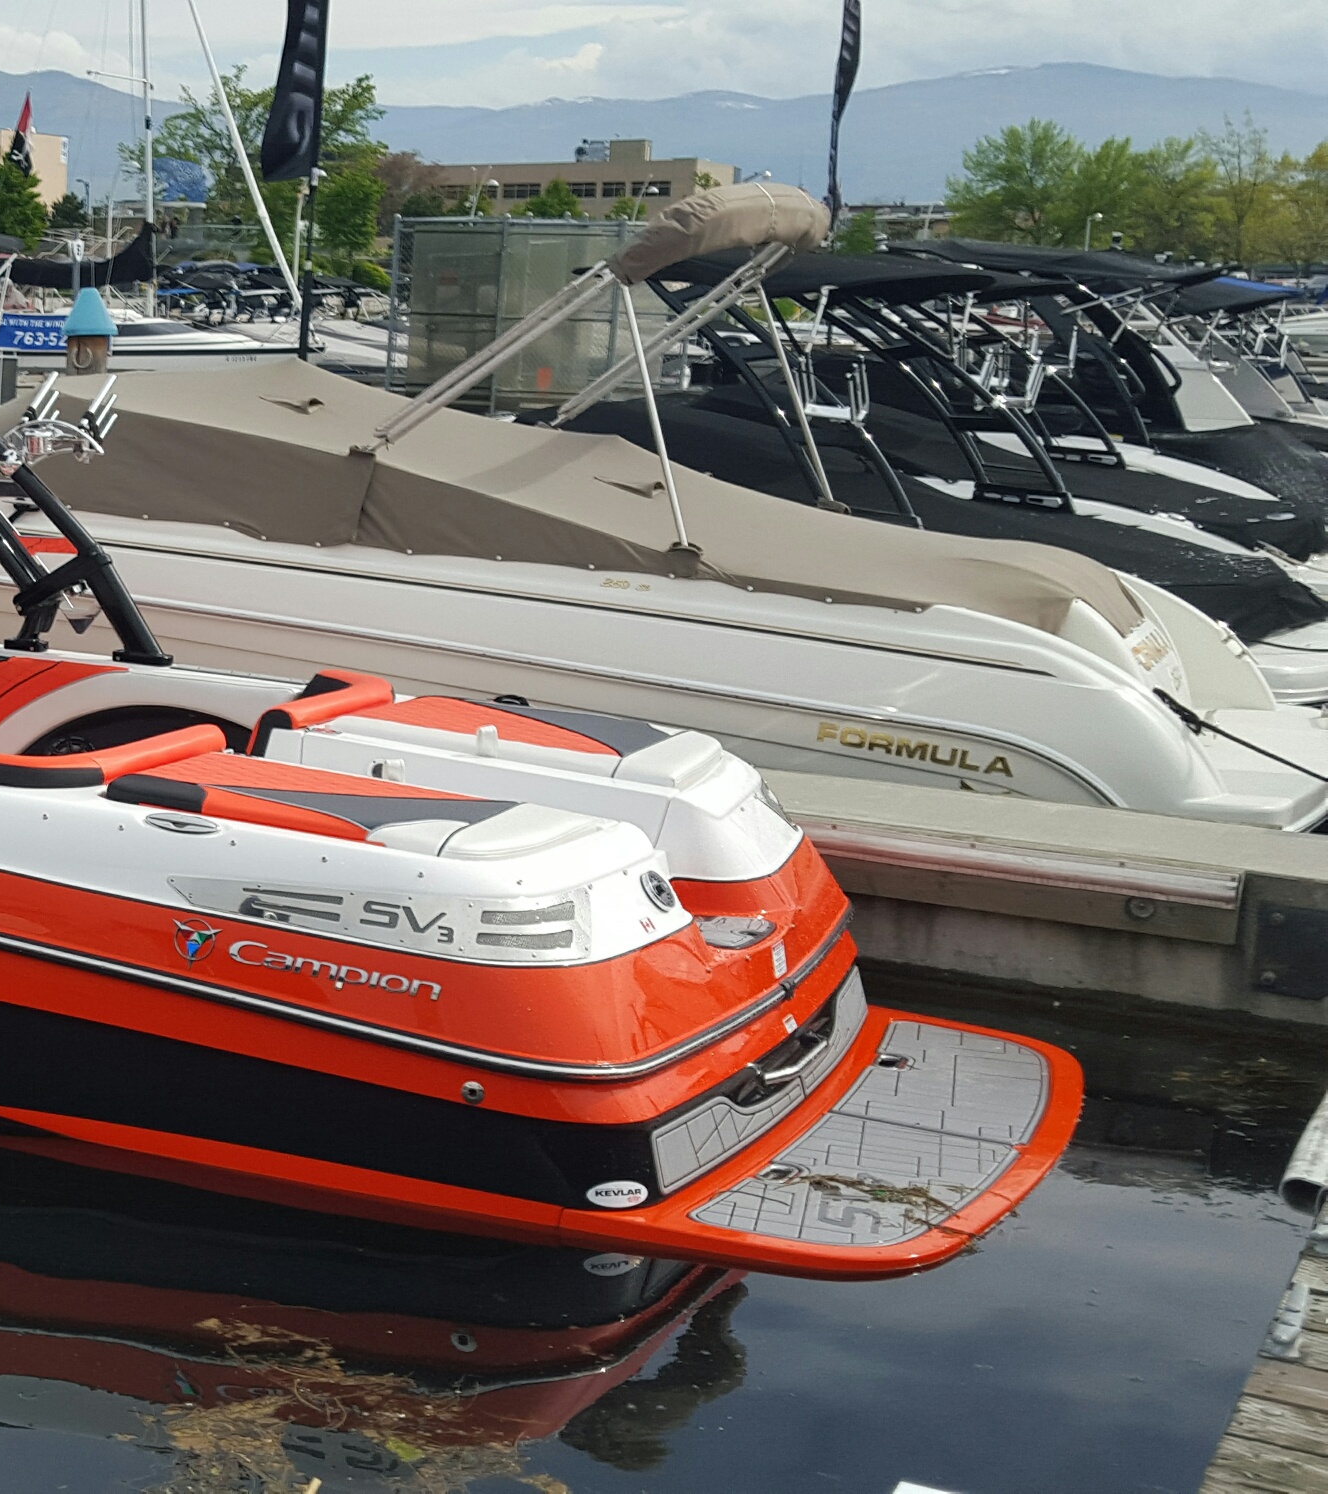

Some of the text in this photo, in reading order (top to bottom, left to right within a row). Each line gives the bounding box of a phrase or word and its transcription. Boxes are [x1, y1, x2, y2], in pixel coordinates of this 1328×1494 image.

[29, 319, 45, 328] THE
[816, 721, 1014, 778] FORMULA
[359, 901, 455, 943] SV3
[228, 940, 442, 1000] Campion
[595, 1188, 642, 1198] KEVLAR
